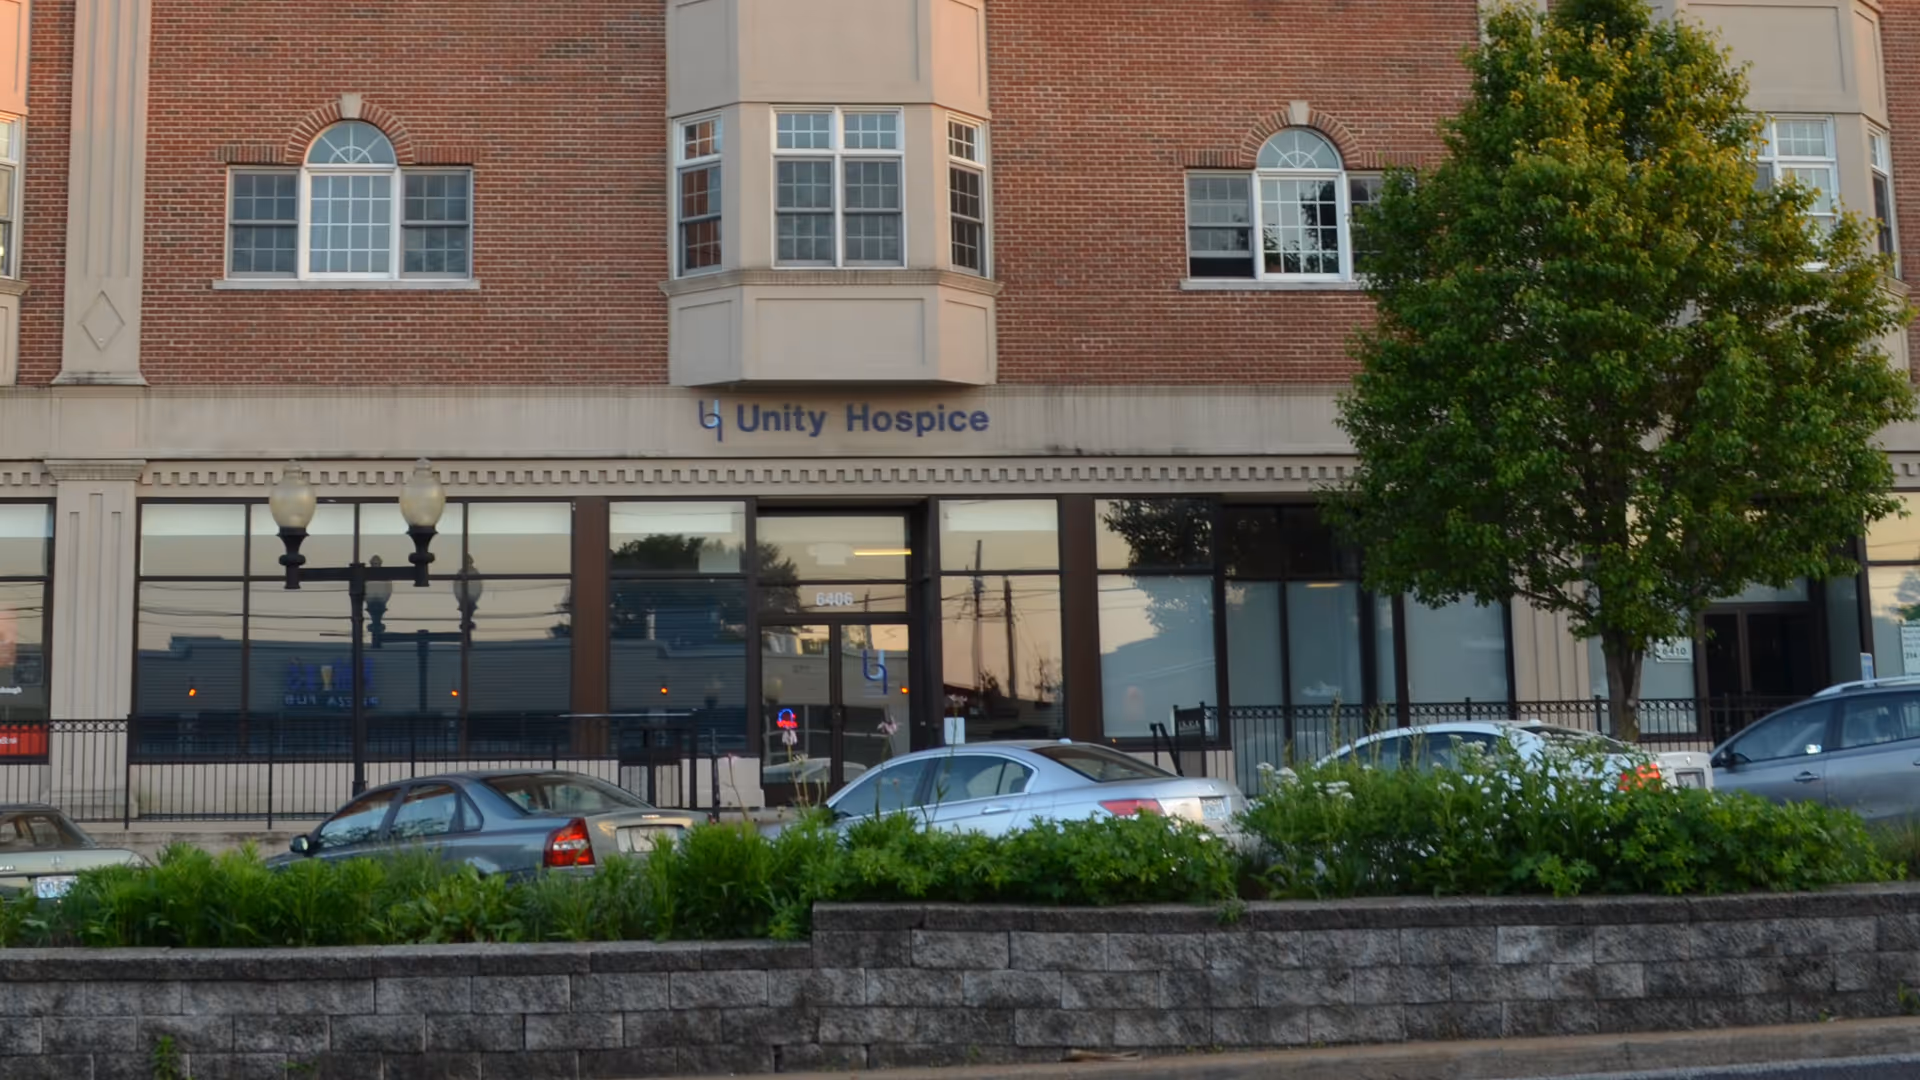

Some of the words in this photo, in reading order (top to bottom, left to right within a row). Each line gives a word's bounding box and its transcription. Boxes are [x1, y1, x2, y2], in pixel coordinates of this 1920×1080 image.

[736, 403, 827, 437] Unity
[846, 403, 990, 437] Hospice
[816, 592, 854, 606] 6406
